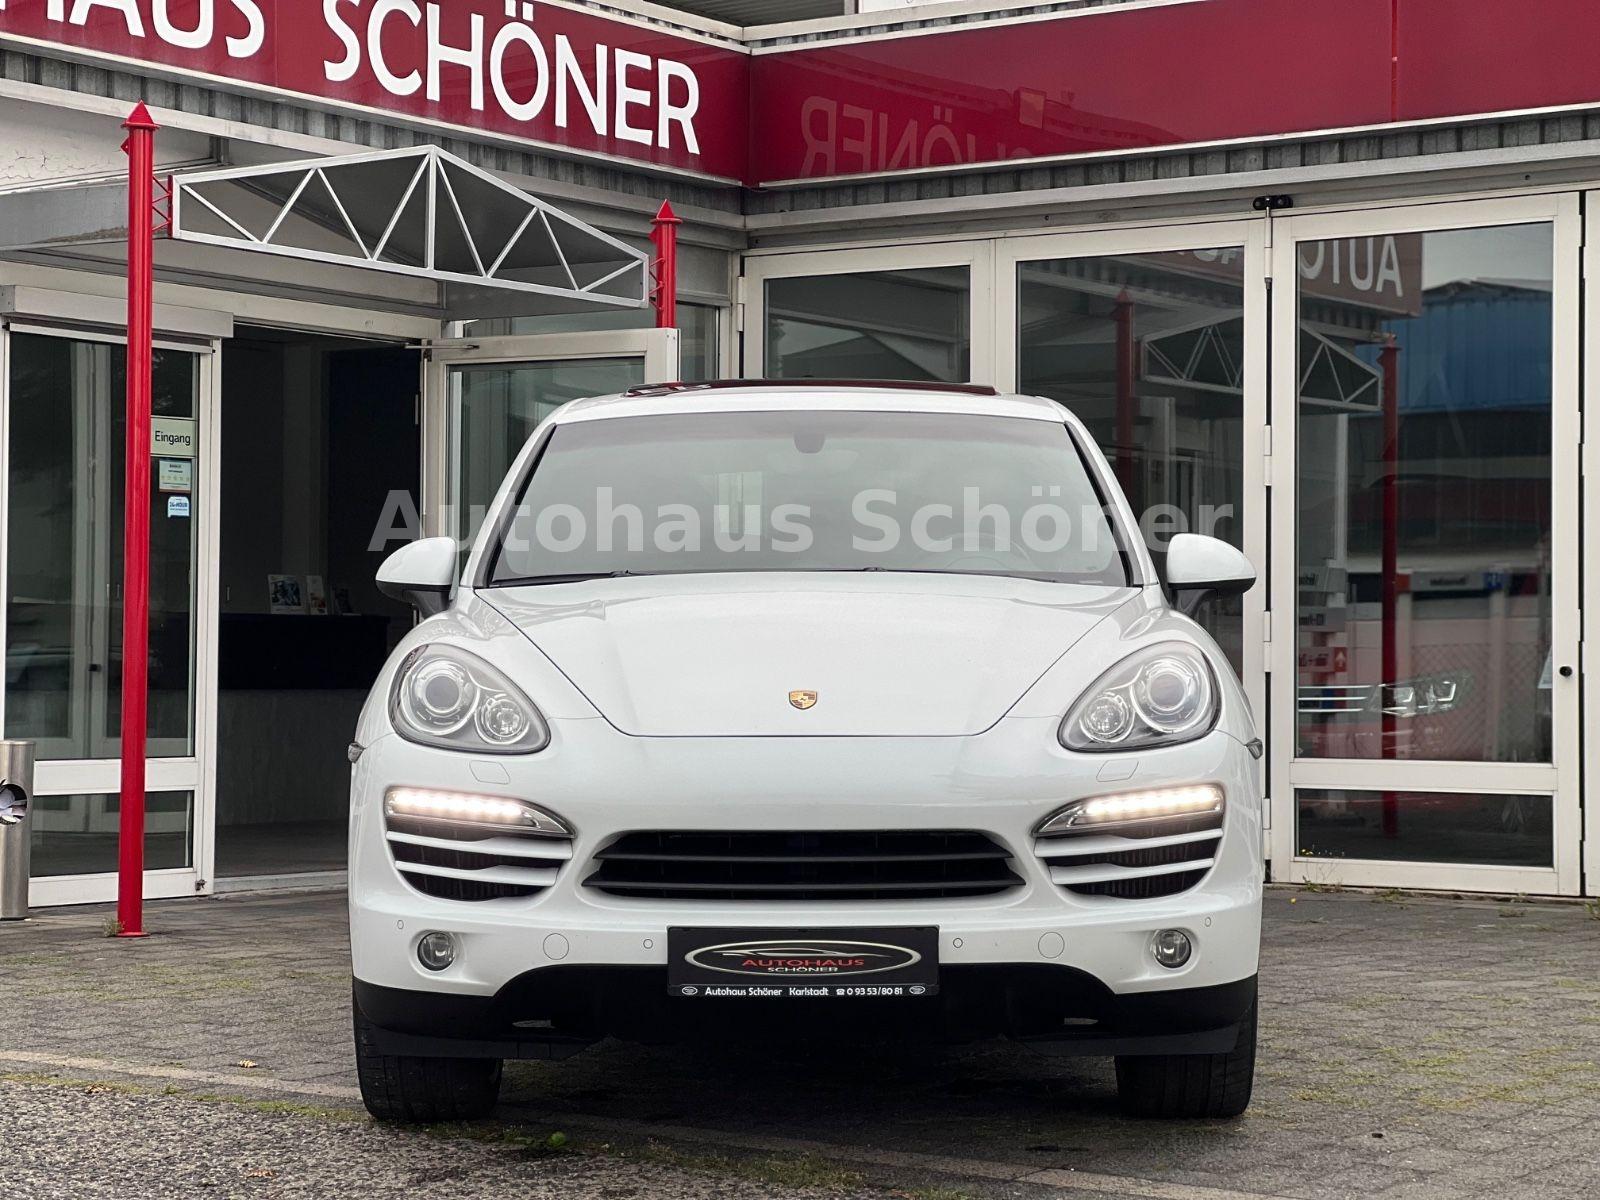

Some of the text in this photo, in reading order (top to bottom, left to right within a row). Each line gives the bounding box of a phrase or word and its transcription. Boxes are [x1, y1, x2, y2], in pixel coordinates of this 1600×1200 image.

[323, 0, 699, 155] SCHÖNER
[154, 430, 191, 446] Eingang
[742, 959, 865, 967] AUTOHAUS
[705, 986, 746, 996] Autohaus
[748, 986, 782, 996] Schöner
[789, 986, 829, 996] Karlstadt
[846, 987, 854, 996] 0
[854, 987, 866, 996] 93
[866, 986, 893, 996] 53/80
[894, 987, 903, 995] 81
